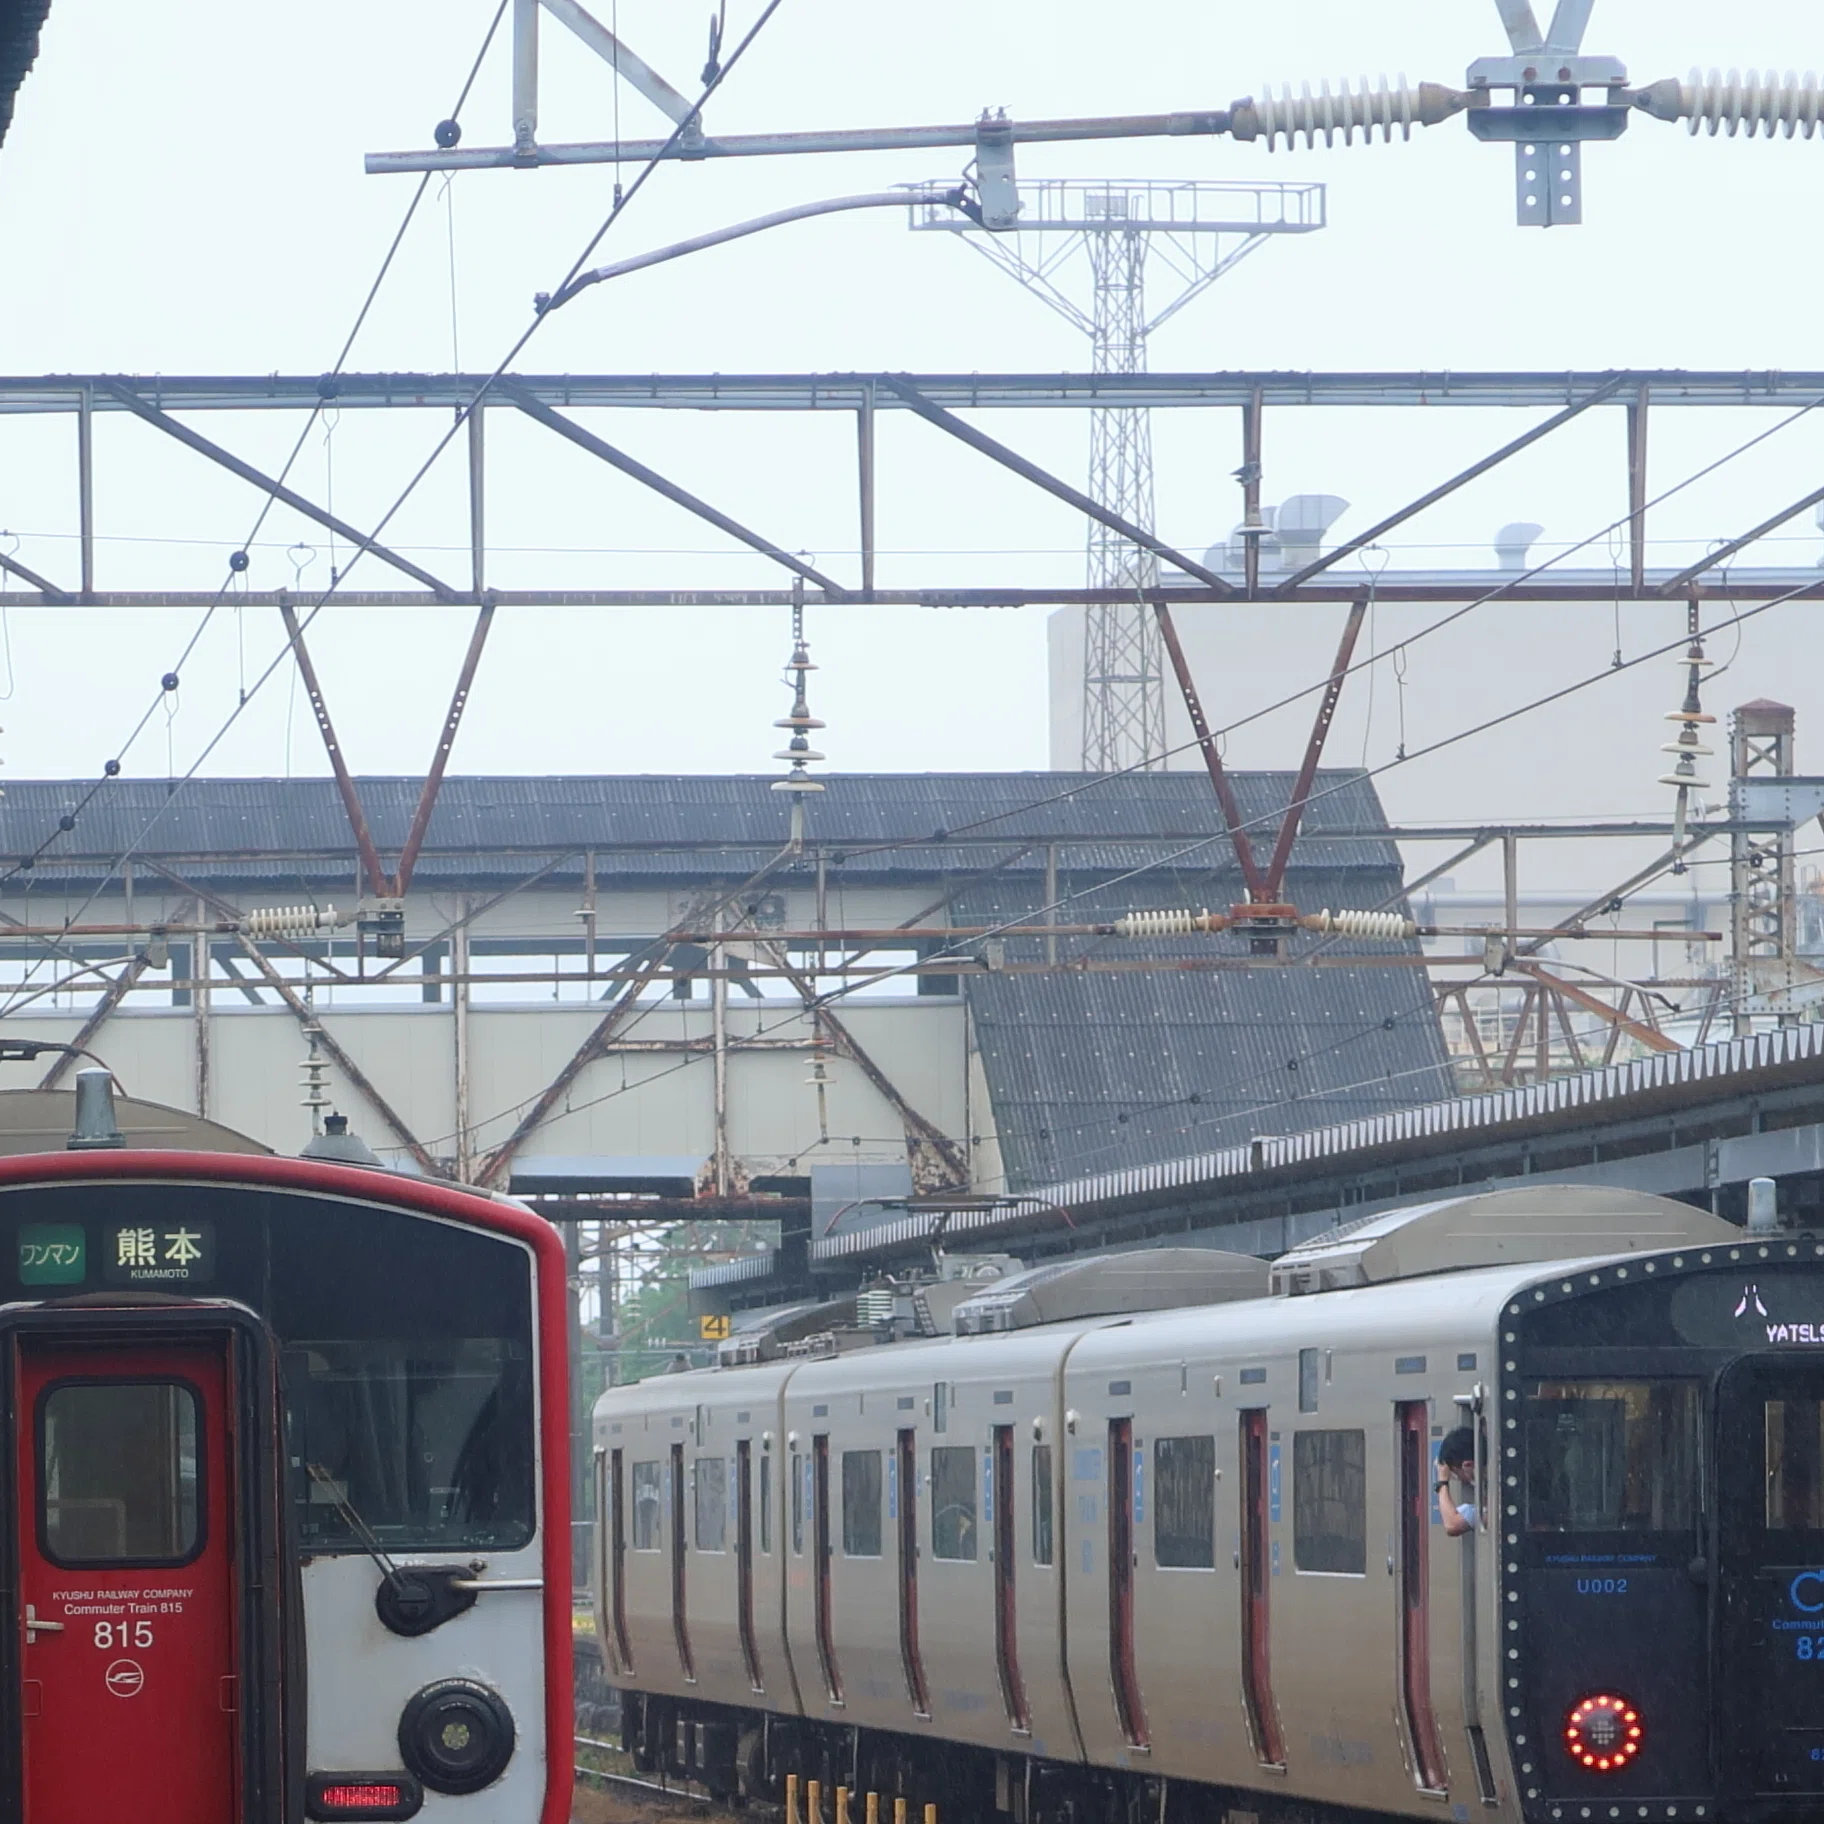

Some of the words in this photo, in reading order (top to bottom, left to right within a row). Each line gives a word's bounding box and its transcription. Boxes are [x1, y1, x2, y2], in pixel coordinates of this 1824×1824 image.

[20, 1243, 80, 1267] ワンマン
[116, 1227, 203, 1267] 熊本
[130, 1269, 189, 1279] KUMAMOTO
[704, 1315, 727, 1337] 4
[52, 1591, 94, 1600] KYUSHU
[97, 1590, 139, 1599] RAILWAY
[143, 1589, 194, 1599] COMPANY
[1576, 1578, 1627, 1593] U002
[64, 1603, 125, 1615] Commuter
[128, 1602, 157, 1614] Train
[160, 1602, 183, 1613] 815
[93, 1620, 154, 1649] 815
